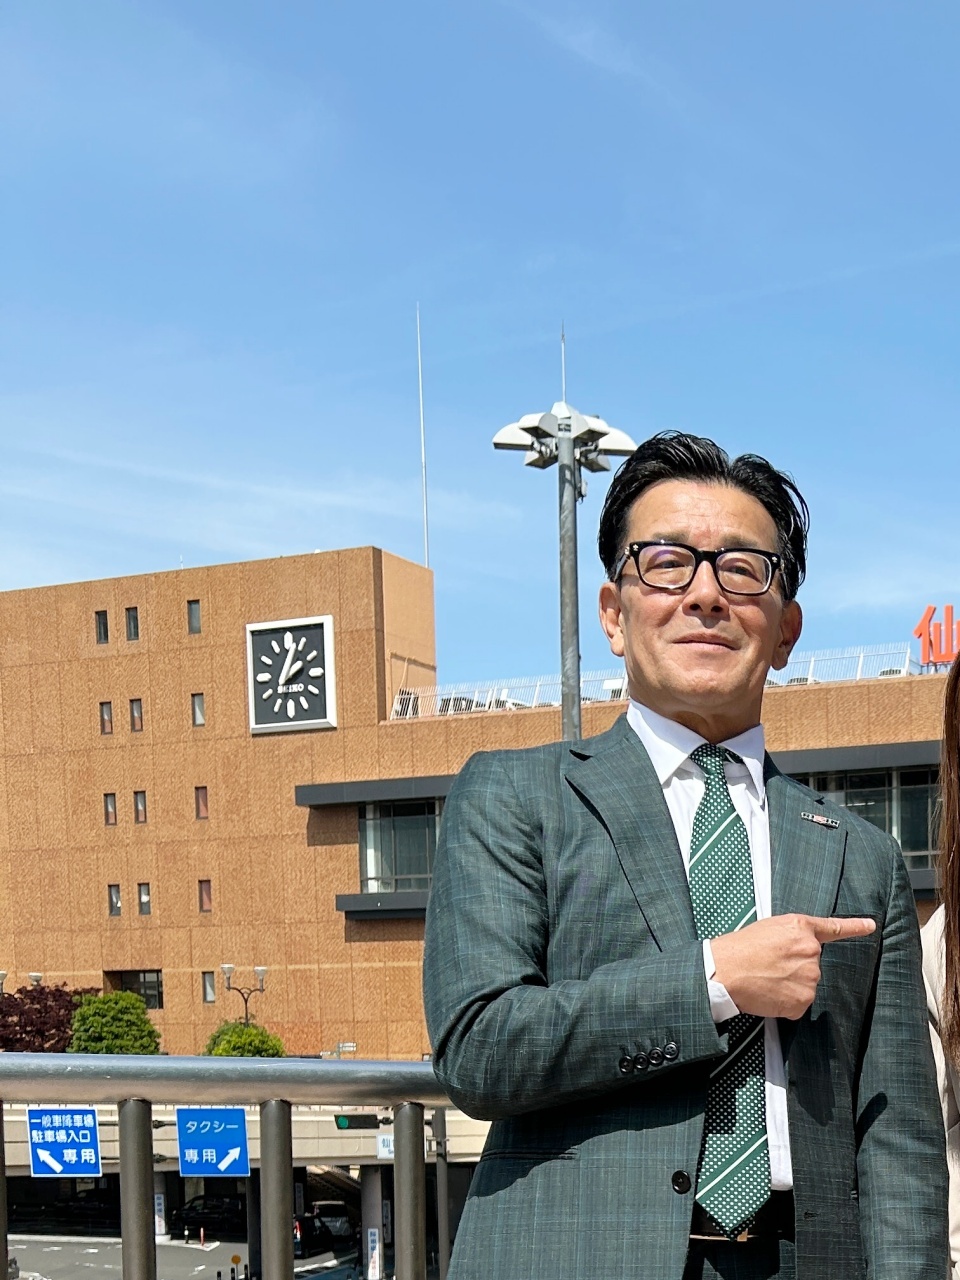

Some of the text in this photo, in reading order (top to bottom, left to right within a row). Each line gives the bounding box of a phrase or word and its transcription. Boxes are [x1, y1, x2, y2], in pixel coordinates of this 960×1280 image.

[30, 1114, 94, 1128] 一般車降車場
[185, 1120, 239, 1134] タクシー
[31, 1129, 91, 1143] 駐車場入口
[62, 1148, 96, 1164] 専用
[184, 1148, 217, 1164] 専用
